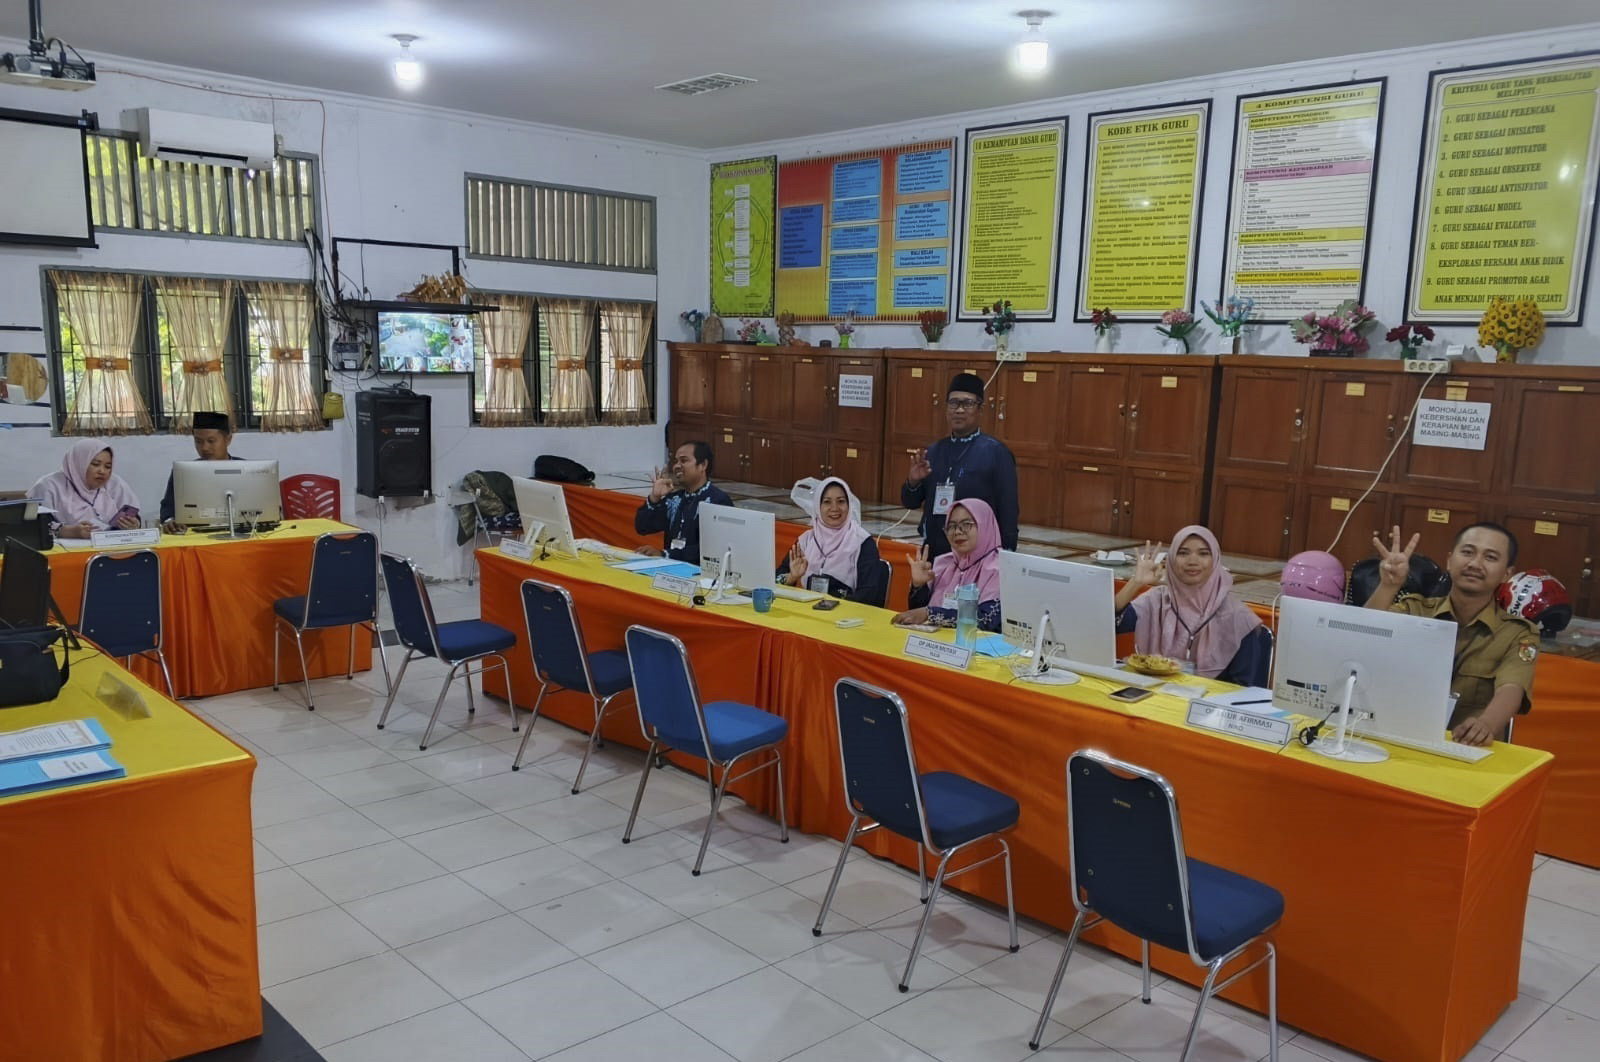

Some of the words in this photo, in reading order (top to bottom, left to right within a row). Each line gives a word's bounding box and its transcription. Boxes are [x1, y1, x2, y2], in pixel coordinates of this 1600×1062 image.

[1451, 83, 1489, 95] KRITERIA
[1490, 80, 1512, 90] GURU
[1514, 78, 1534, 88] YANG
[1496, 87, 1536, 98] MELIPUTI
[1264, 94, 1332, 108] KOMPETENSI
[1455, 112, 1476, 123] GURU
[1477, 109, 1508, 121] SEBAGAI
[1510, 104, 1556, 117] PERENCANA
[1107, 126, 1133, 136] KODE
[1135, 123, 1159, 133] ETIK
[1161, 119, 1190, 130] GURU
[1453, 132, 1473, 142] GURU
[1474, 128, 1506, 140] SEBAGAI
[1507, 124, 1546, 137] INISIATOR
[983, 138, 1018, 150] KEMAMPUAN
[1020, 135, 1039, 145] DASAR
[1040, 133, 1057, 143] GURU
[1451, 150, 1471, 160] GURU
[1472, 147, 1503, 158] SEBAGAI
[1505, 143, 1547, 156] MOTIVATOR
[1449, 168, 1469, 178] GURU
[1470, 165, 1500, 176] SEBAGAI
[1502, 162, 1542, 175] OBSERVER
[1446, 187, 1466, 196] GURU
[1467, 184, 1498, 195] SEBAGAI
[1444, 206, 1464, 214] GURU
[1465, 203, 1496, 214] SEBAGAI
[1497, 202, 1522, 212] MODEL
[1442, 223, 1461, 232] GURU
[1462, 222, 1494, 232] SEBAGAI
[1495, 220, 1537, 230] EVALUATOR
[1440, 242, 1460, 250] GURU
[1460, 240, 1491, 250] SEBAGAI
[1493, 239, 1518, 248] TEMAN
[1438, 258, 1482, 268] EKSPLORASI
[1483, 257, 1518, 267] BERSAMA
[1520, 256, 1541, 266] ANAK
[1542, 256, 1565, 265] DIDIK
[1436, 276, 1456, 286] GURU
[1456, 276, 1486, 285] SEBAGAI
[1488, 276, 1528, 285] PROMOTOR
[1529, 275, 1550, 284] AGAR
[1434, 295, 1453, 304] ANAK
[1454, 294, 1485, 304] MENJADI
[1536, 294, 1562, 303] SEJATI
[1428, 406, 1456, 414] MOHON
[1420, 414, 1468, 423] KEBERSIHAN
[1469, 416, 1486, 424] DAN
[1421, 422, 1460, 430] KERAPIAN
[1460, 424, 1481, 432] MEJA
[1420, 430, 1480, 440] MASING-MASING
[1239, 714, 1273, 728] AFIRMASI
